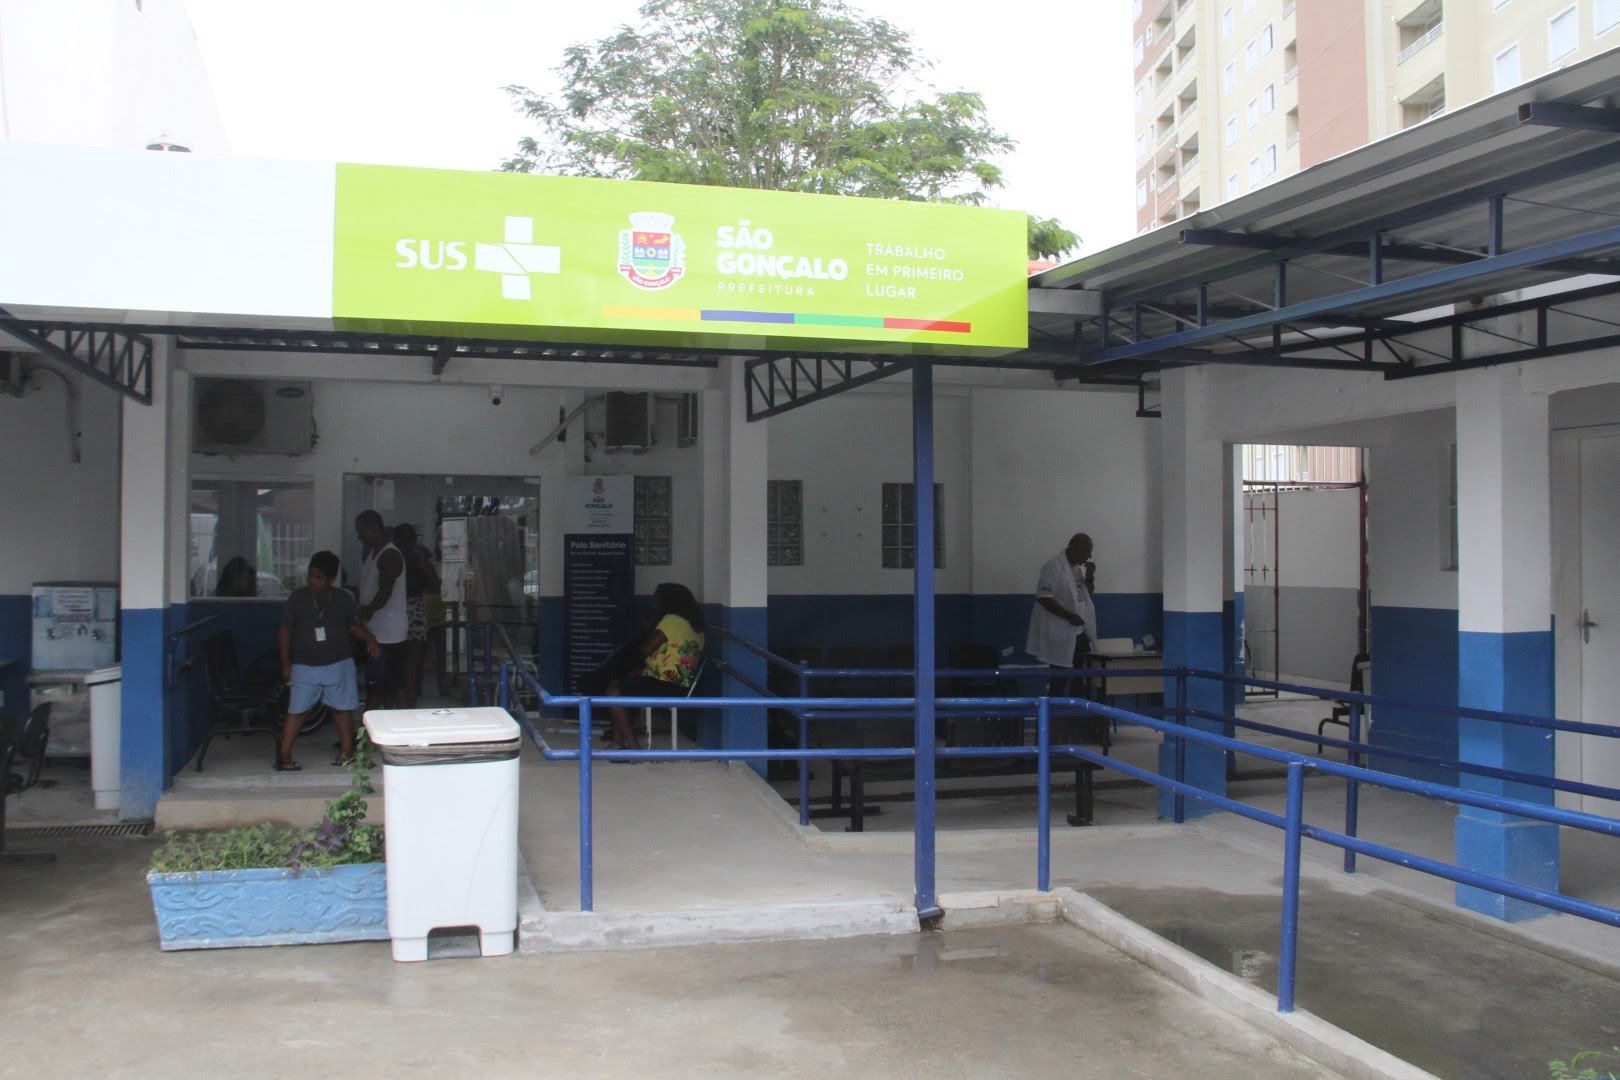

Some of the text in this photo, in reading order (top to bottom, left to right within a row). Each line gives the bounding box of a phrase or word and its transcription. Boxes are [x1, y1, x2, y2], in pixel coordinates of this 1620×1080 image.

[716, 219, 774, 250] SÃO
[396, 238, 467, 270] SUS
[866, 242, 946, 260] TRABALHO
[716, 251, 849, 281] GONÇALO
[866, 263, 964, 281] EM PRIMEIRO
[718, 281, 815, 297] PREFEITURA
[866, 284, 917, 299] LUGAR
[570, 540, 626, 549] Polo Sanitário
